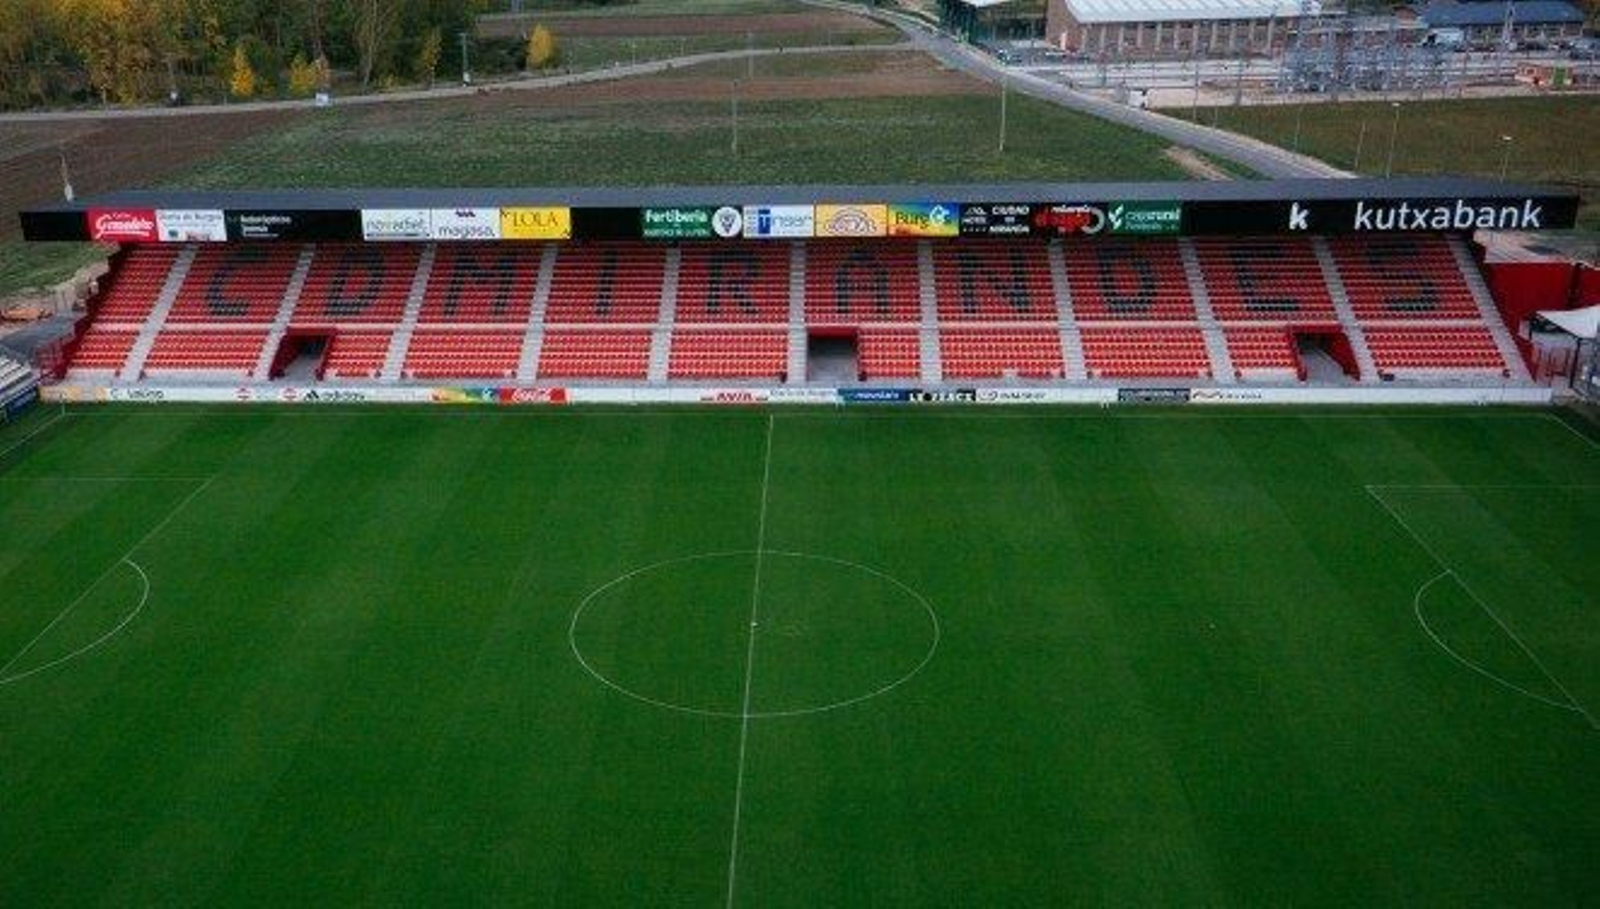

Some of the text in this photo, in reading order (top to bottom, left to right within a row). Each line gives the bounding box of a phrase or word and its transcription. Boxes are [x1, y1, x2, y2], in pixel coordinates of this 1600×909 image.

[511, 211, 559, 228] LOLA
[1289, 202, 1309, 230] k
[1354, 200, 1541, 231] kutxabank
